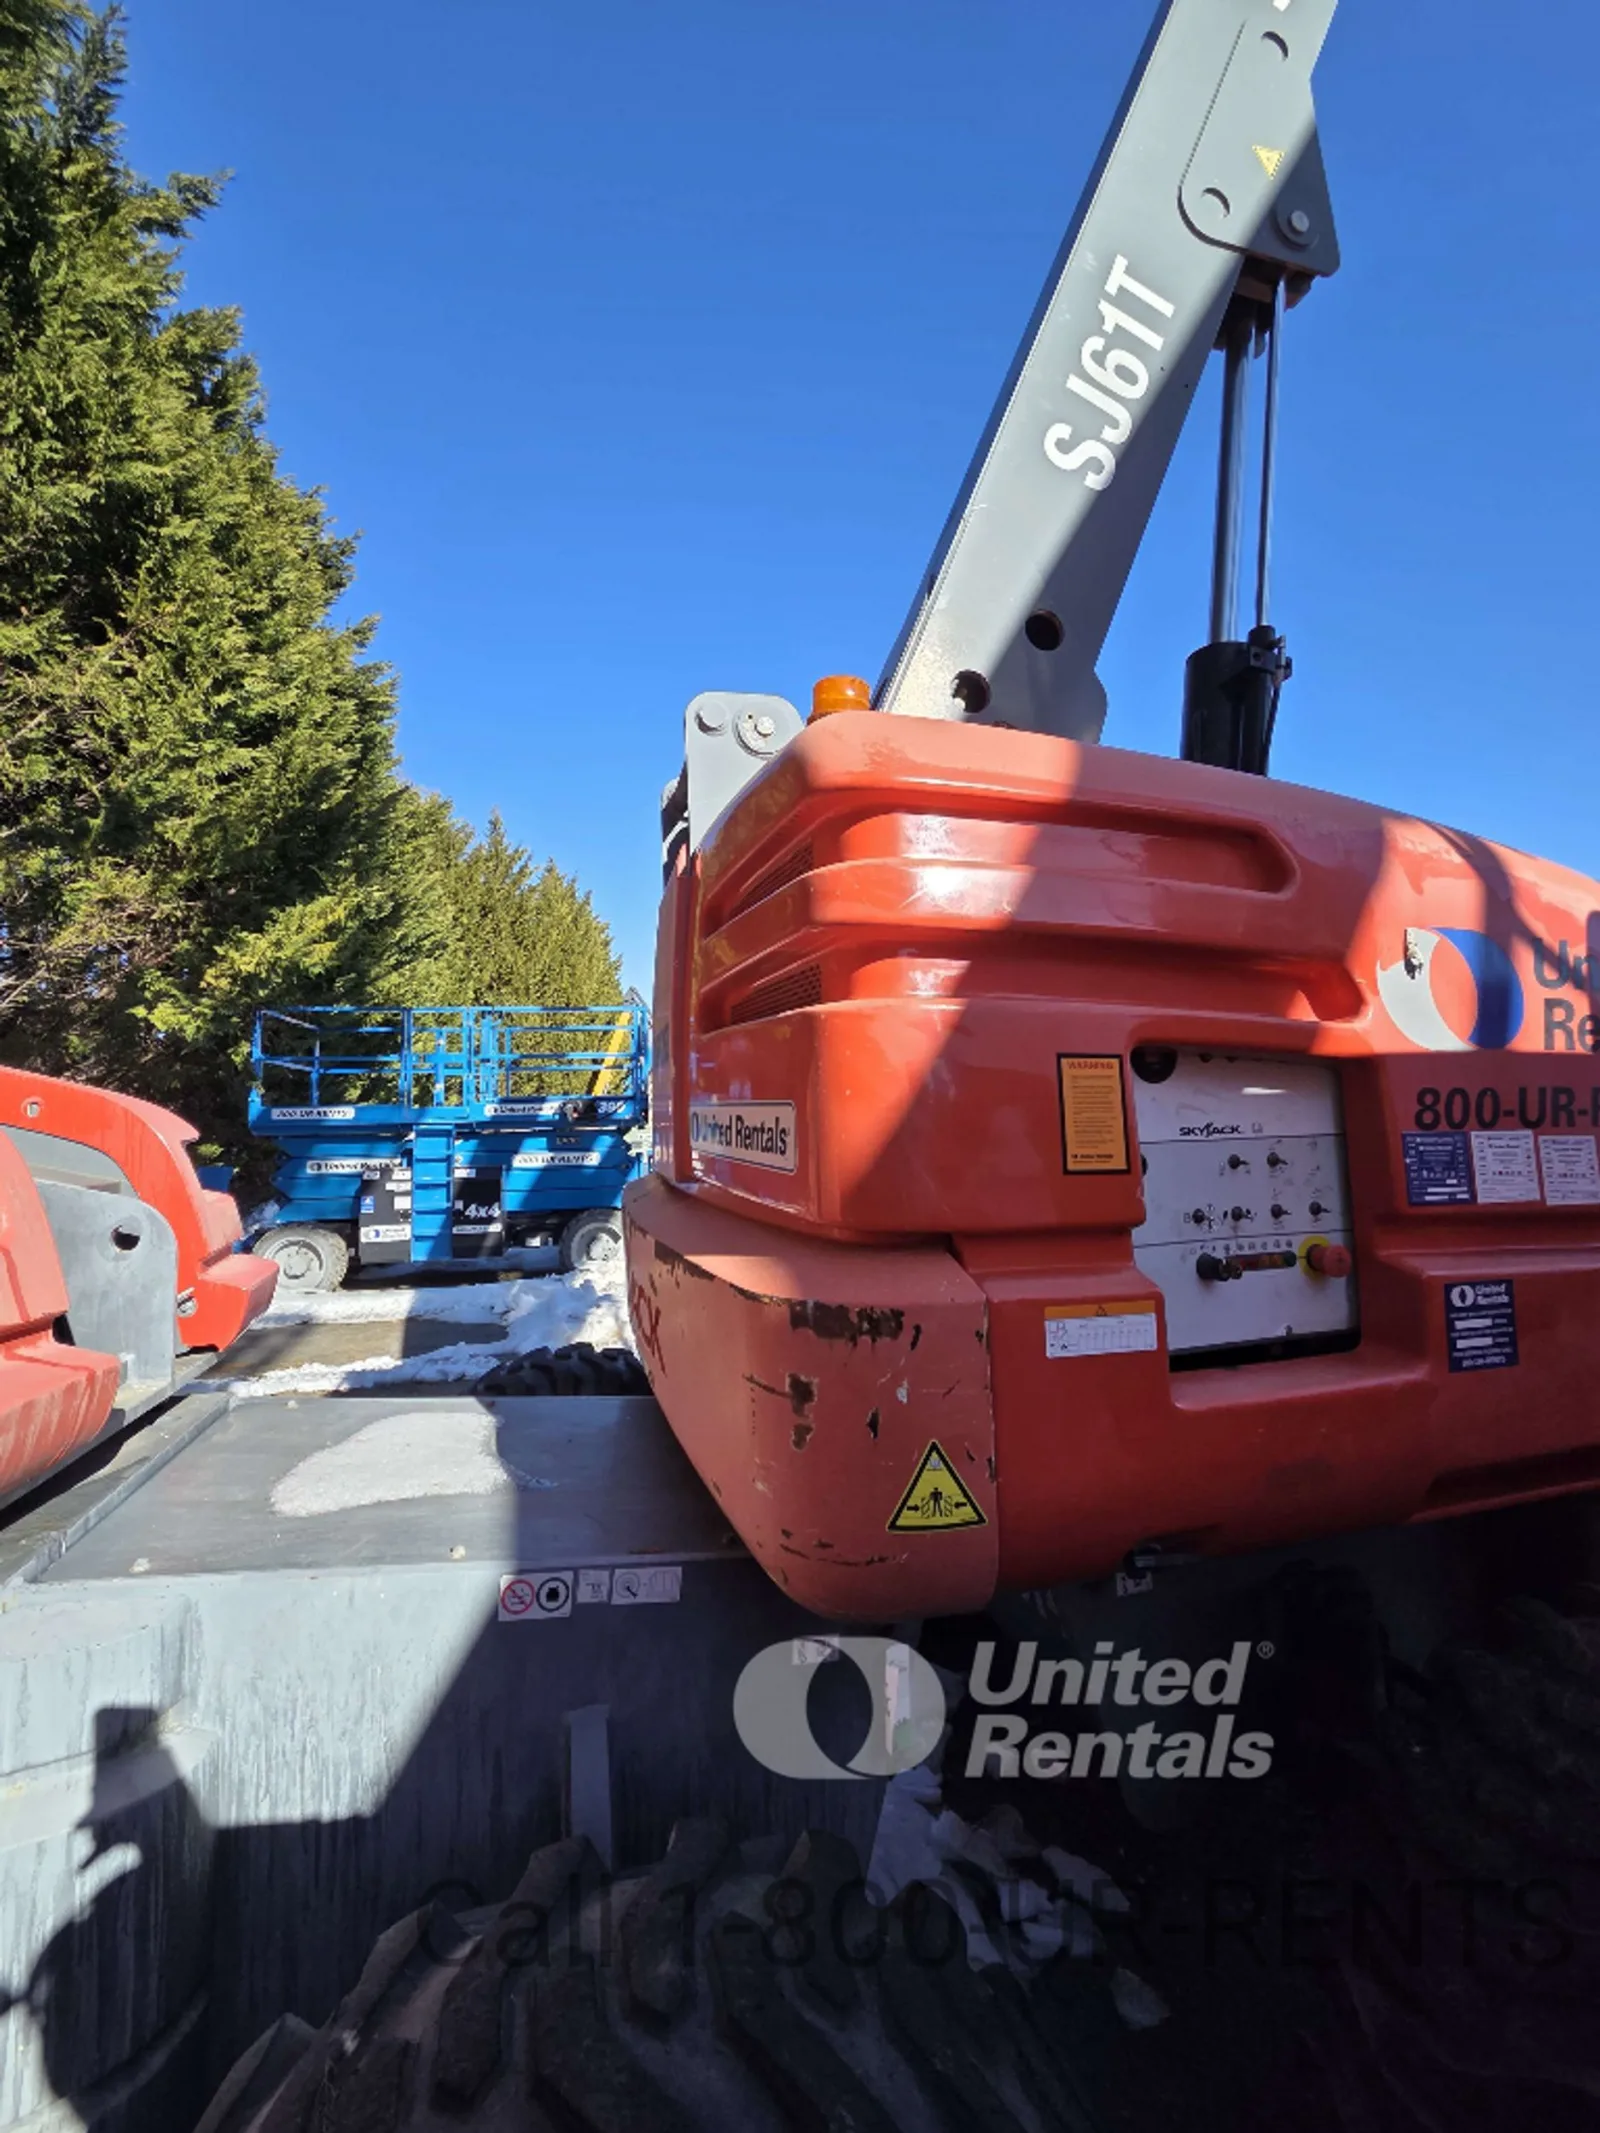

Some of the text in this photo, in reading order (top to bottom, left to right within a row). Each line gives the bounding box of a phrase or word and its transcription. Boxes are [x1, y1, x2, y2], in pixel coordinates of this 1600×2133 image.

[1043, 253, 1176, 491] SJ61T
[1543, 998, 1600, 1054] Re
[1179, 1121, 1242, 1138] SKYJACK
[1413, 1085, 1600, 1131] 800-UR-
[735, 1115, 787, 1156] Rentals
[465, 1202, 501, 1219] 4x4
